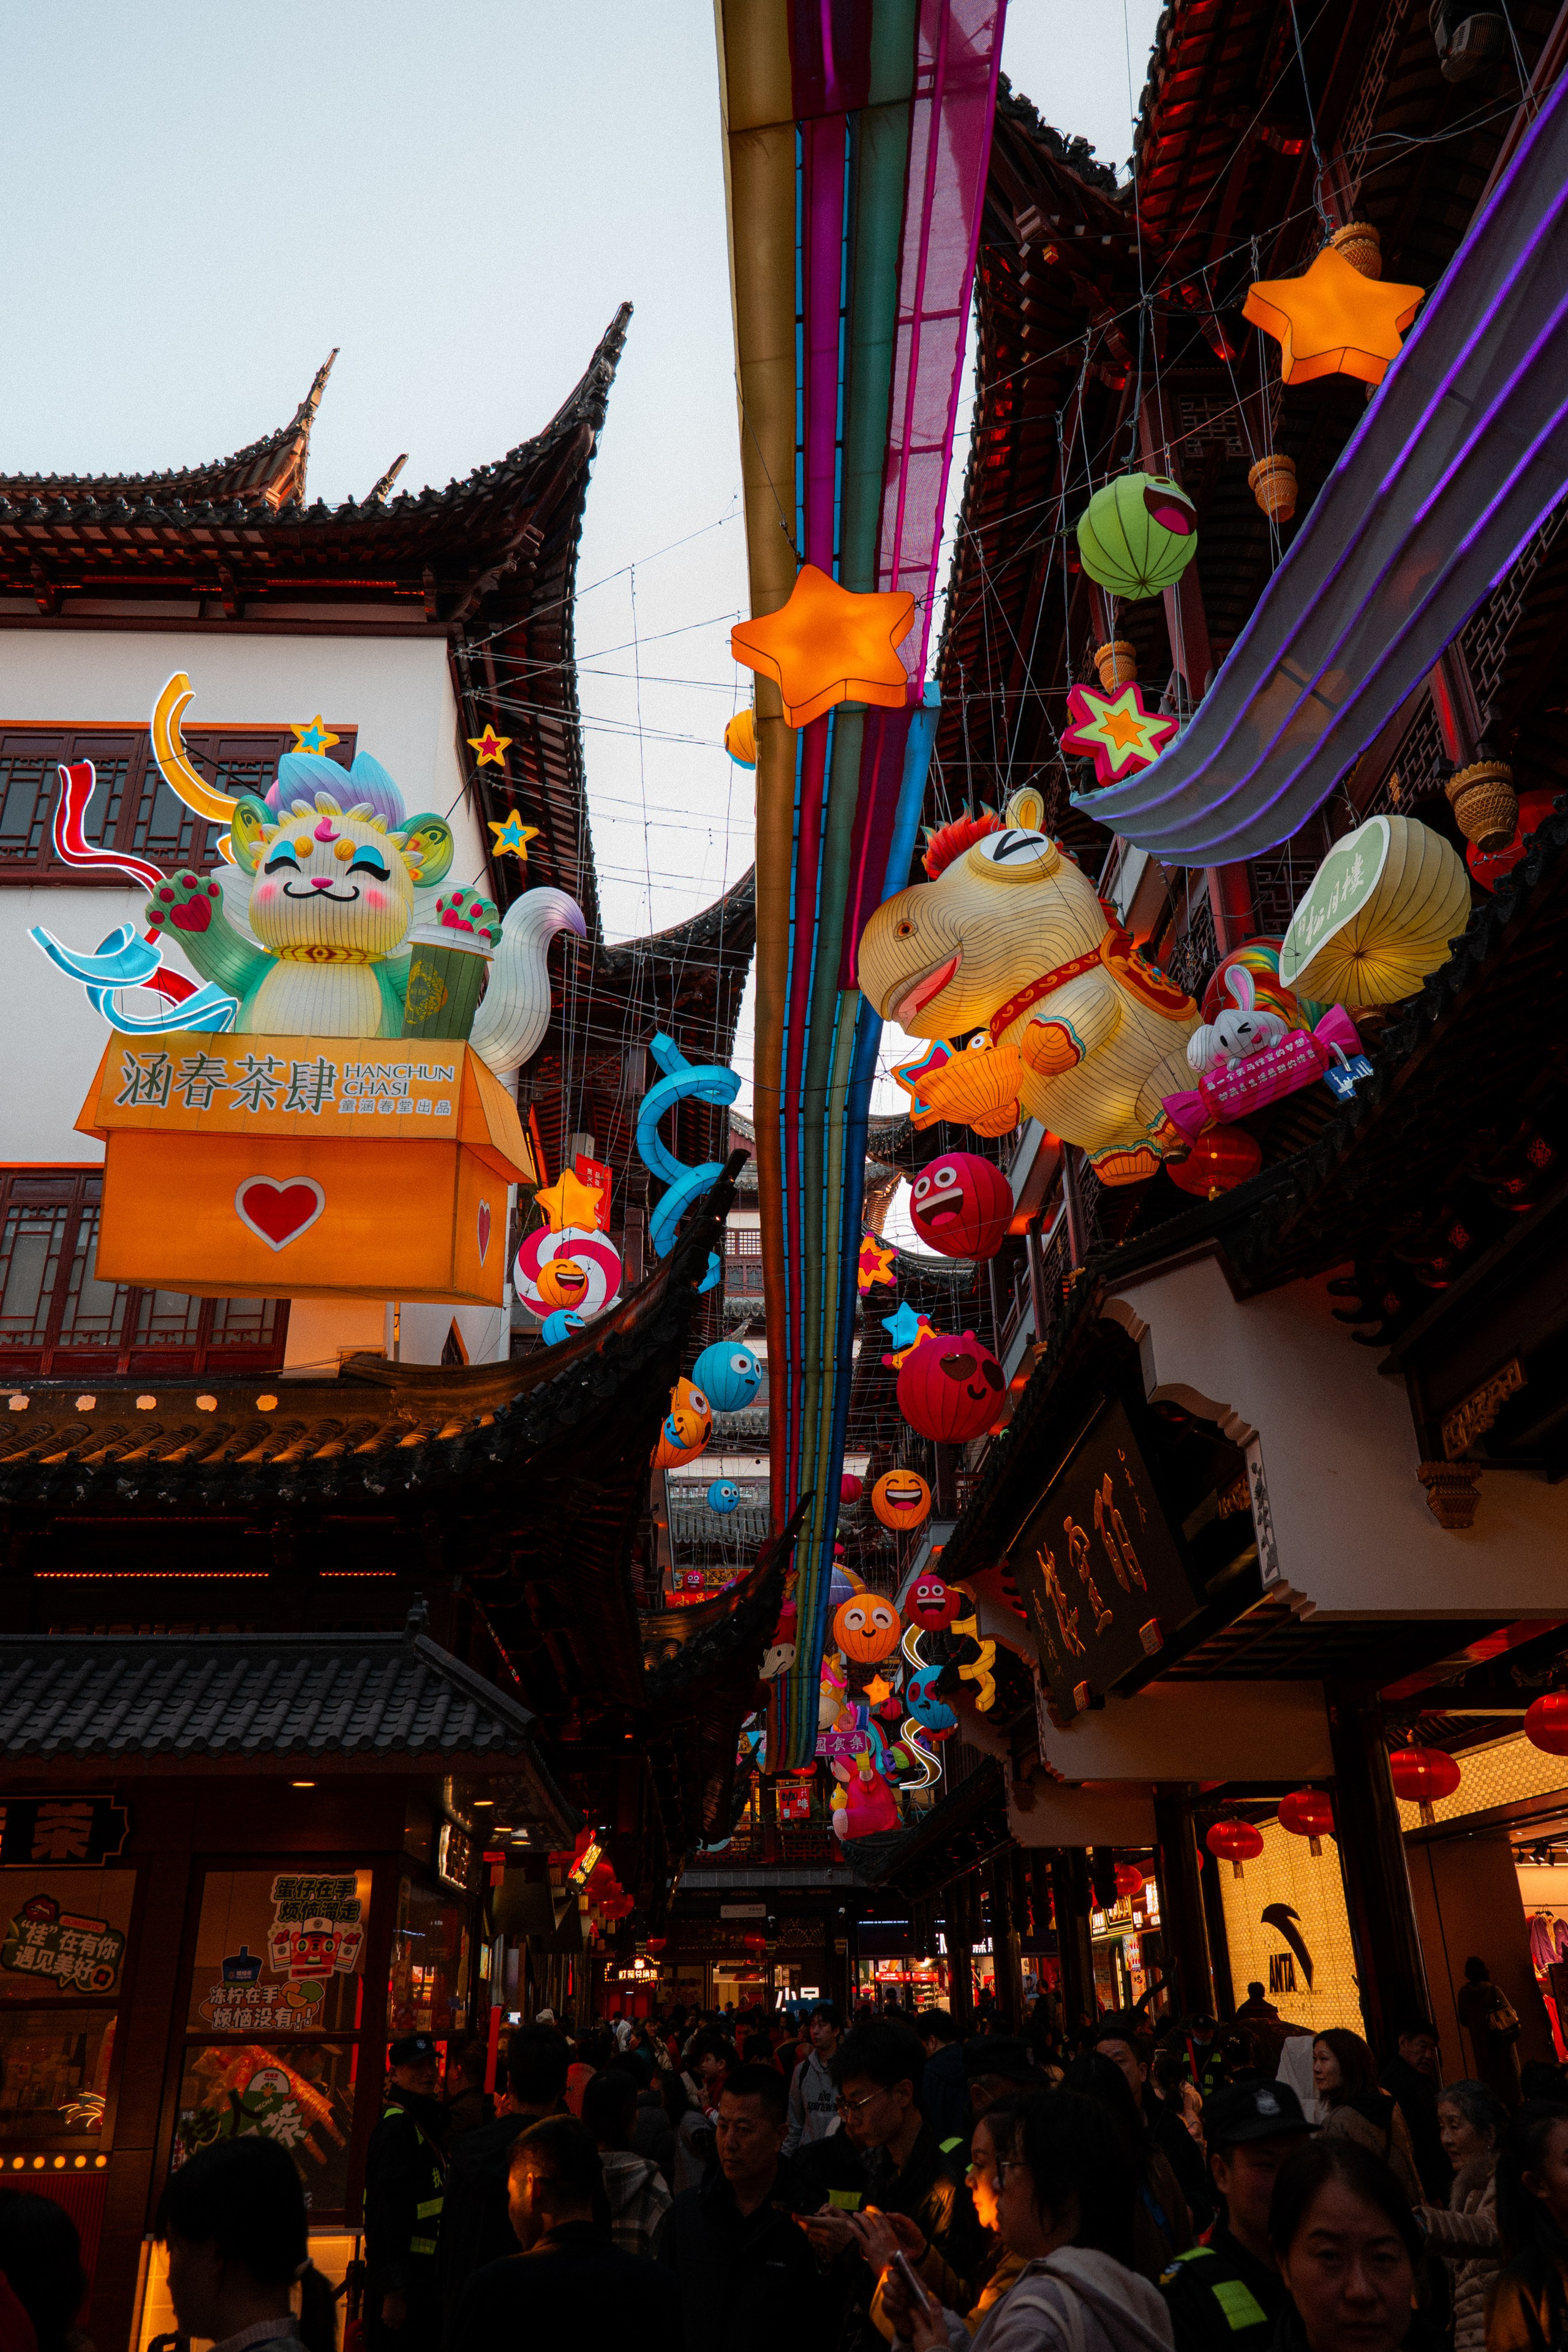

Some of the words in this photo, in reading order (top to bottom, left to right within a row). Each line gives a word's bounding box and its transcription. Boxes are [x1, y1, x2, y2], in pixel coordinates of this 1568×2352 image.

[116, 1050, 336, 1114] 涵春茶肆
[345, 1064, 454, 1080] HANCHUN
[344, 1081, 409, 1096] CHASI
[341, 1099, 451, 1115] 童涵春堂出品
[0, 1802, 95, 1860] 茶
[275, 1877, 356, 1900] 蛋仔在手
[277, 1899, 361, 1923] 烦恼溜走
[13, 1945, 96, 1981] 遇见美好
[1269, 1953, 1297, 1993] ANTA
[210, 1986, 279, 2004] 冻柠在手
[254, 2097, 274, 2112] HECHA
